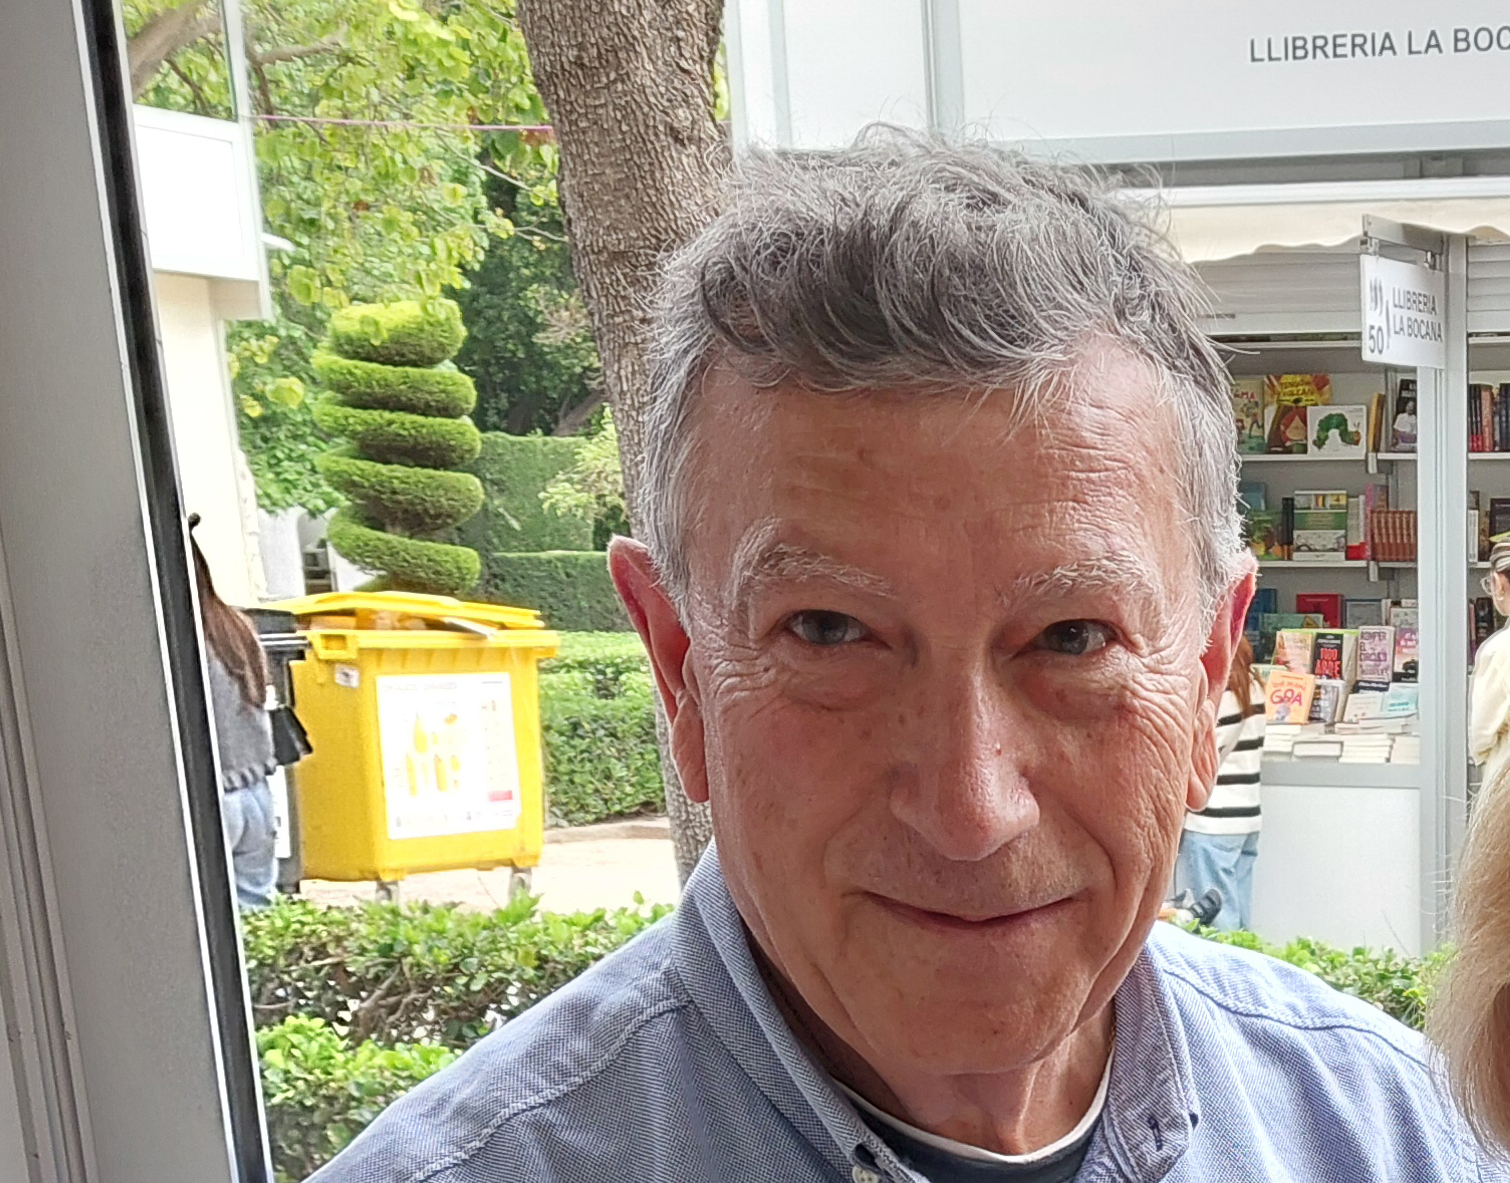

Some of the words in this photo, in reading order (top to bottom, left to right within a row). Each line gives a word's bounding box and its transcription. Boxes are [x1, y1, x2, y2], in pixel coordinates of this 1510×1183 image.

[1250, 32, 1397, 62] LLIBRERIA
[1407, 29, 1443, 55] LA
[1393, 287, 1437, 315] LLIBRERIA
[1369, 324, 1384, 355] 50
[1393, 314, 1405, 336] LA
[1407, 316, 1443, 342] BOCANA
